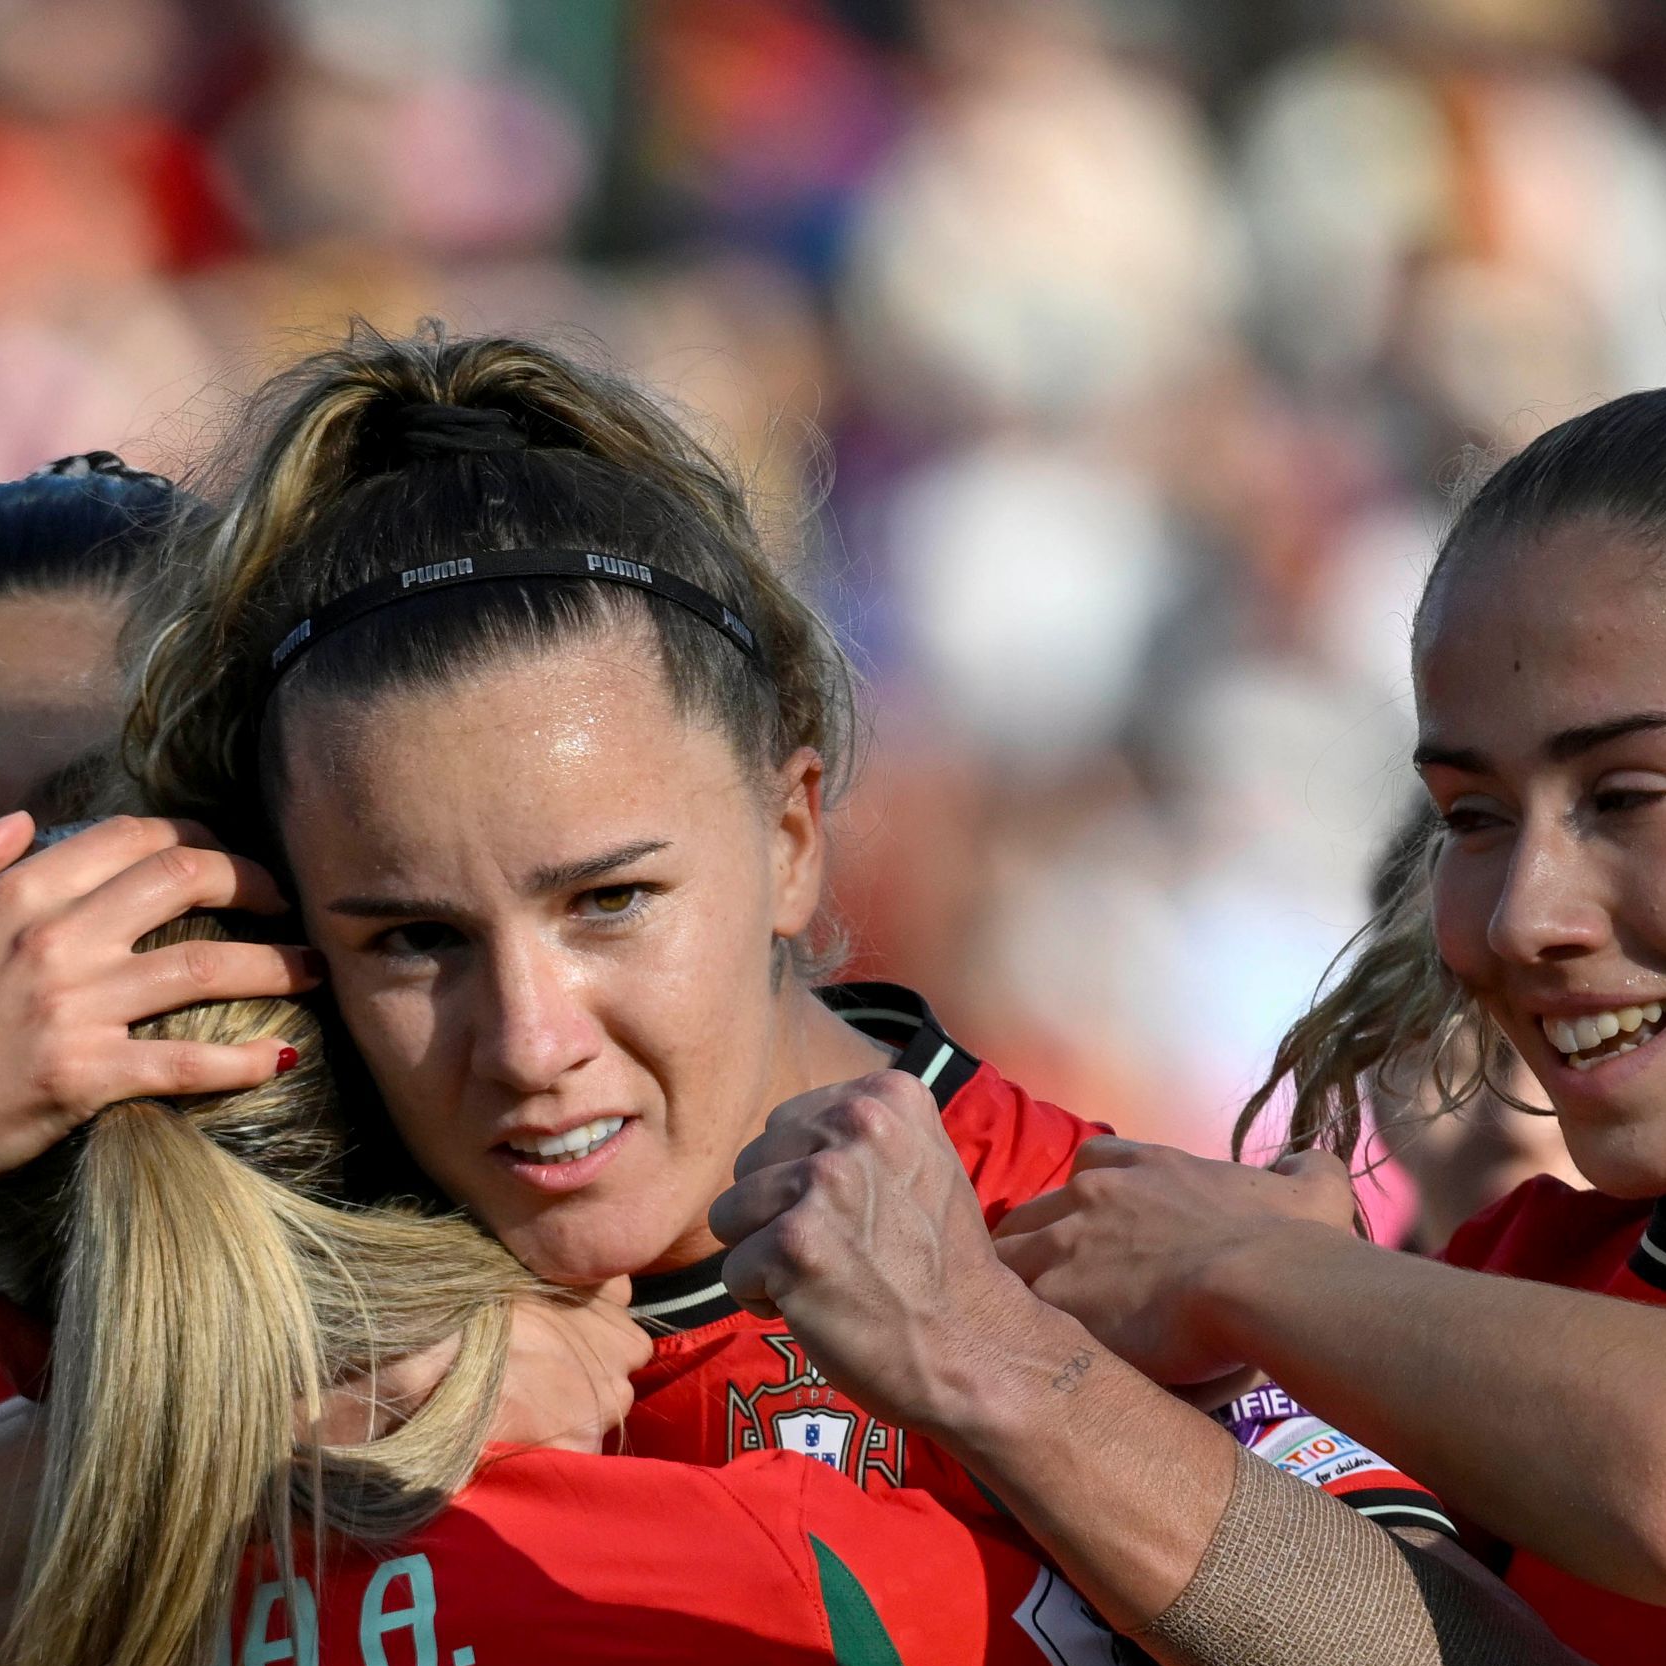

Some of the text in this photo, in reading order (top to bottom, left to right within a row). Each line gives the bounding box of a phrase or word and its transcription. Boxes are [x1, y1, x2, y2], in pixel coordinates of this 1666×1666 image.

[402, 557, 474, 588] PUMA
[586, 554, 653, 584] PUMA
[1315, 1457, 1375, 1486] for children
